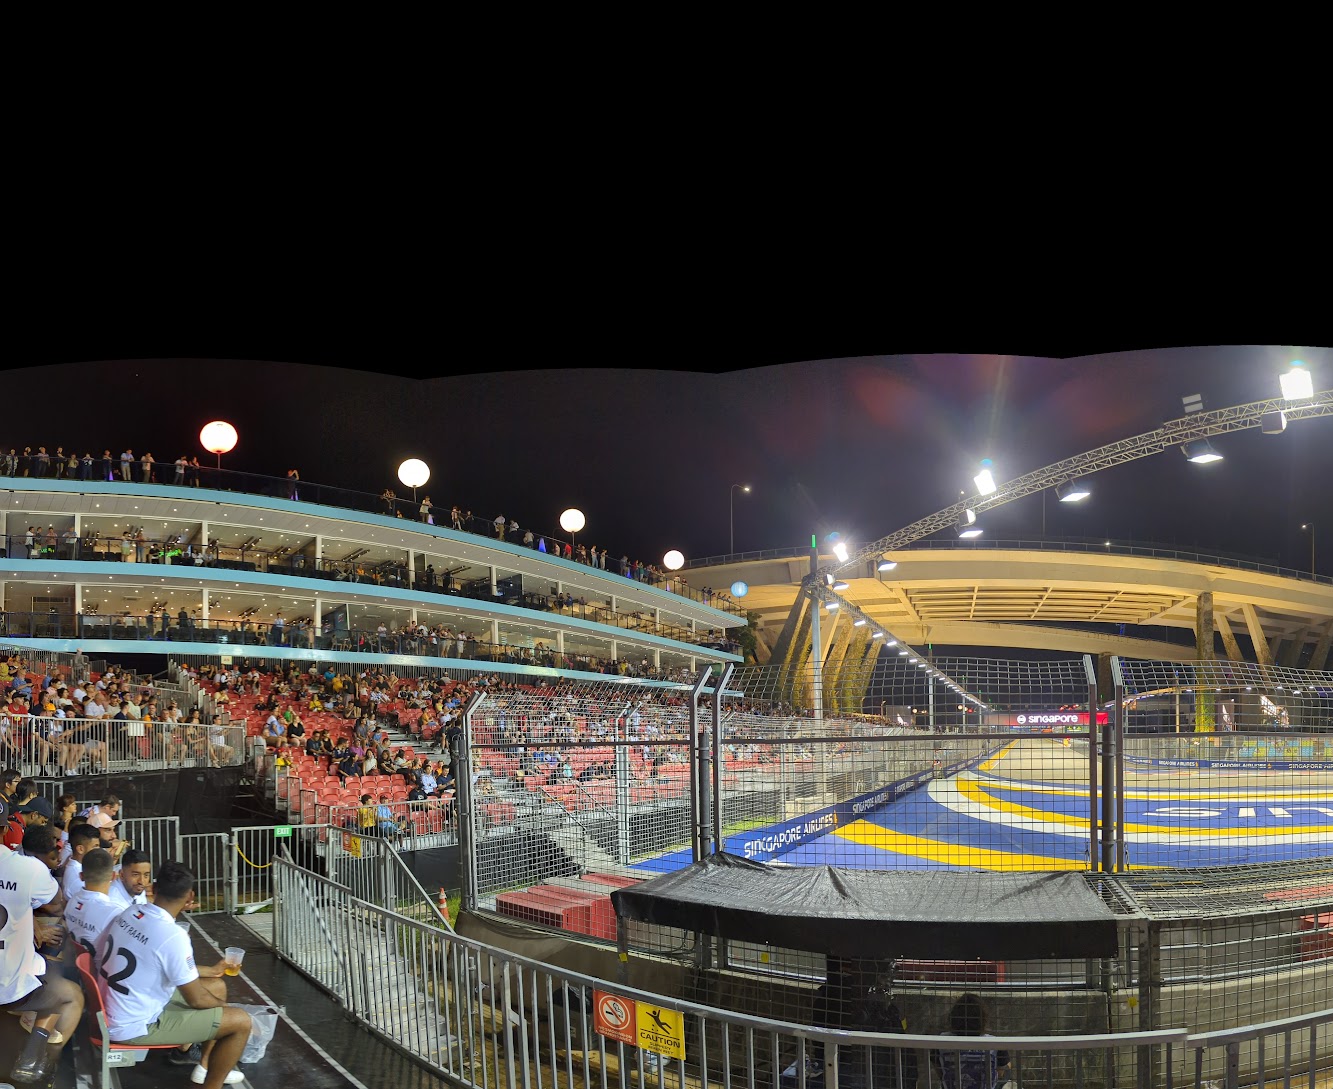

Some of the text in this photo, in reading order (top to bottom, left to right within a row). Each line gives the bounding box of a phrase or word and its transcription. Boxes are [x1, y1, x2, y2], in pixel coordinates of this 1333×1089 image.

[277, 827, 289, 835] EXIT
[802, 812, 833, 838] AIRLINES
[128, 926, 149, 946] RAAM
[99, 933, 137, 997] 22
[640, 1031, 681, 1049] CAUTION
